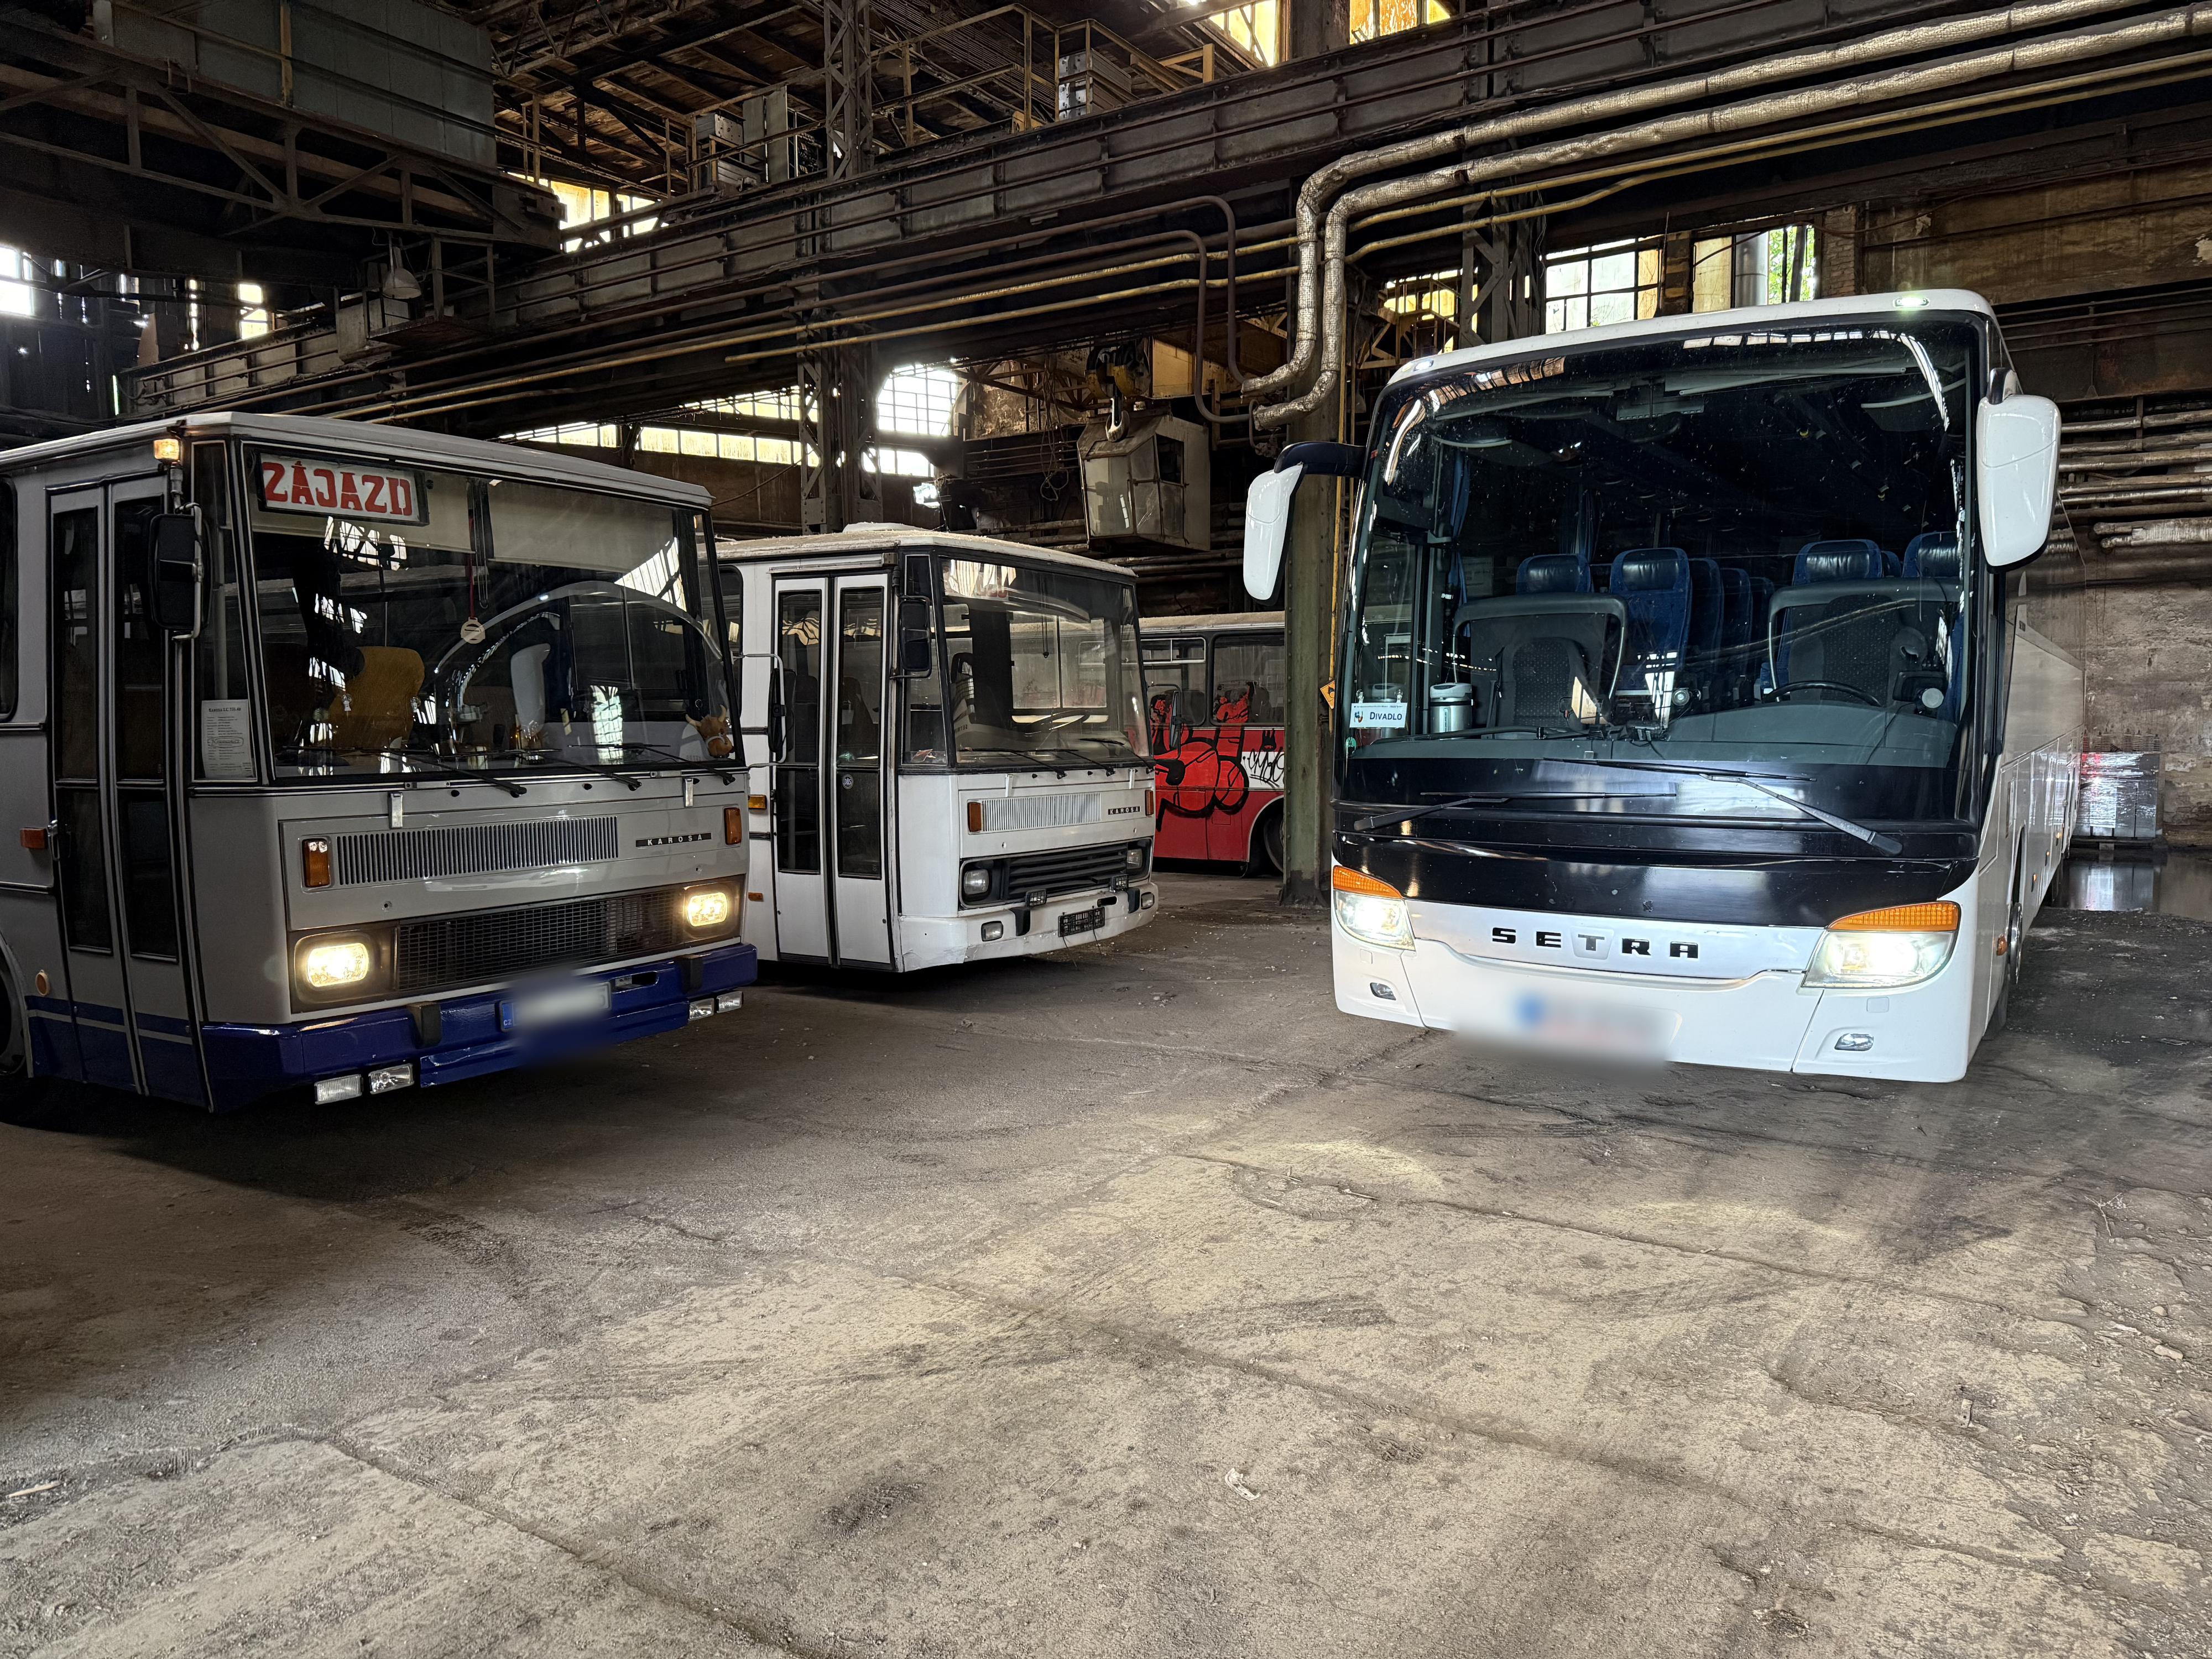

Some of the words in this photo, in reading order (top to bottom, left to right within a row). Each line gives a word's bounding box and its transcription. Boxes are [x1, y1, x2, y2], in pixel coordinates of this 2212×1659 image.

[262, 461, 412, 516] ZÁJAZD
[1110, 806, 1139, 815] KAROSA
[648, 834, 702, 846] KAROSA
[1492, 927, 1698, 959] SETRA
